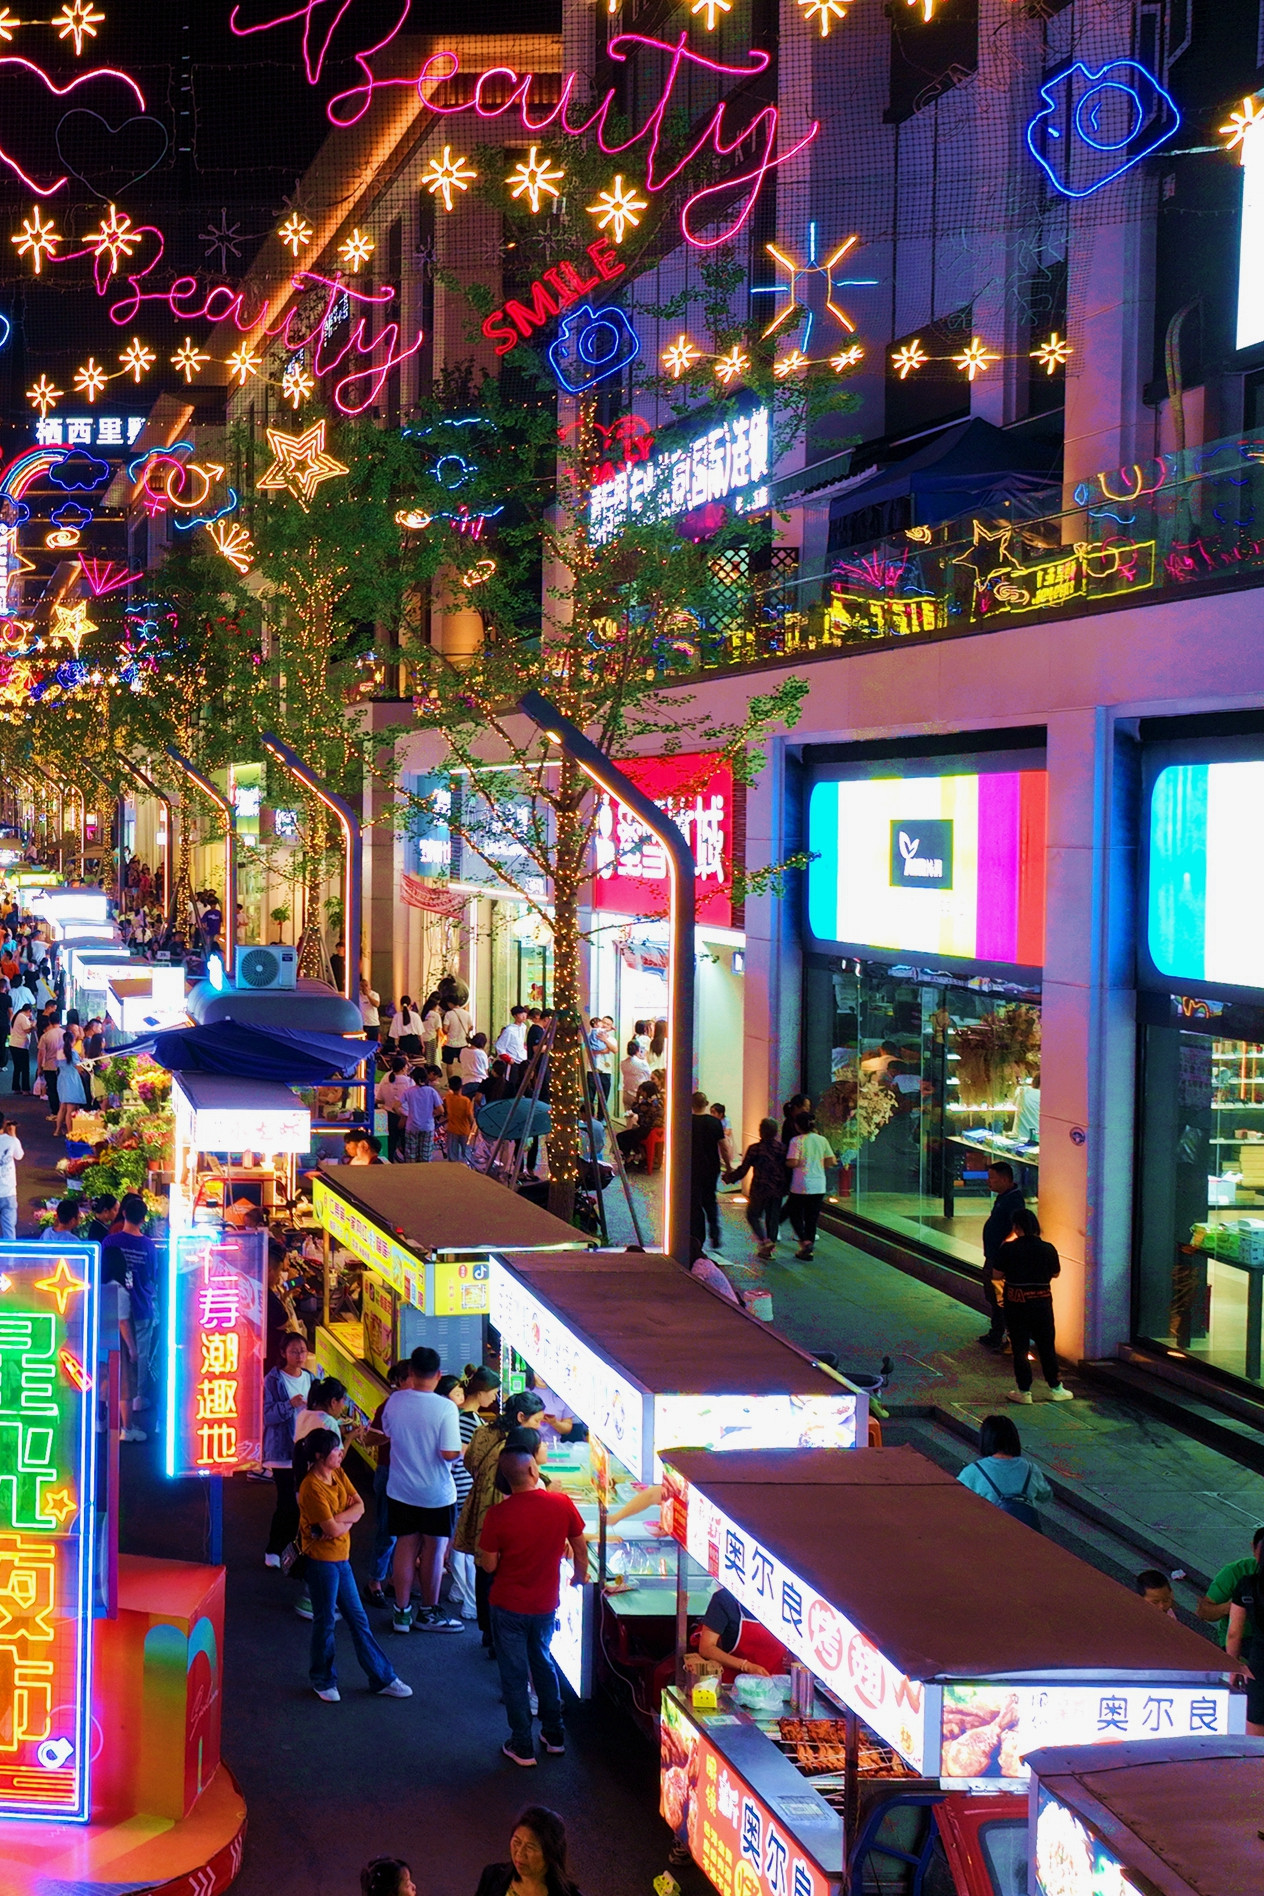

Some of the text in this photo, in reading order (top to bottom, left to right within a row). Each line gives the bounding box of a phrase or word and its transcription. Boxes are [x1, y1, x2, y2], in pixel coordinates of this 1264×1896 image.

[481, 237, 627, 357] SMILE
[1097, 1695, 1218, 1732] 奥尔良
